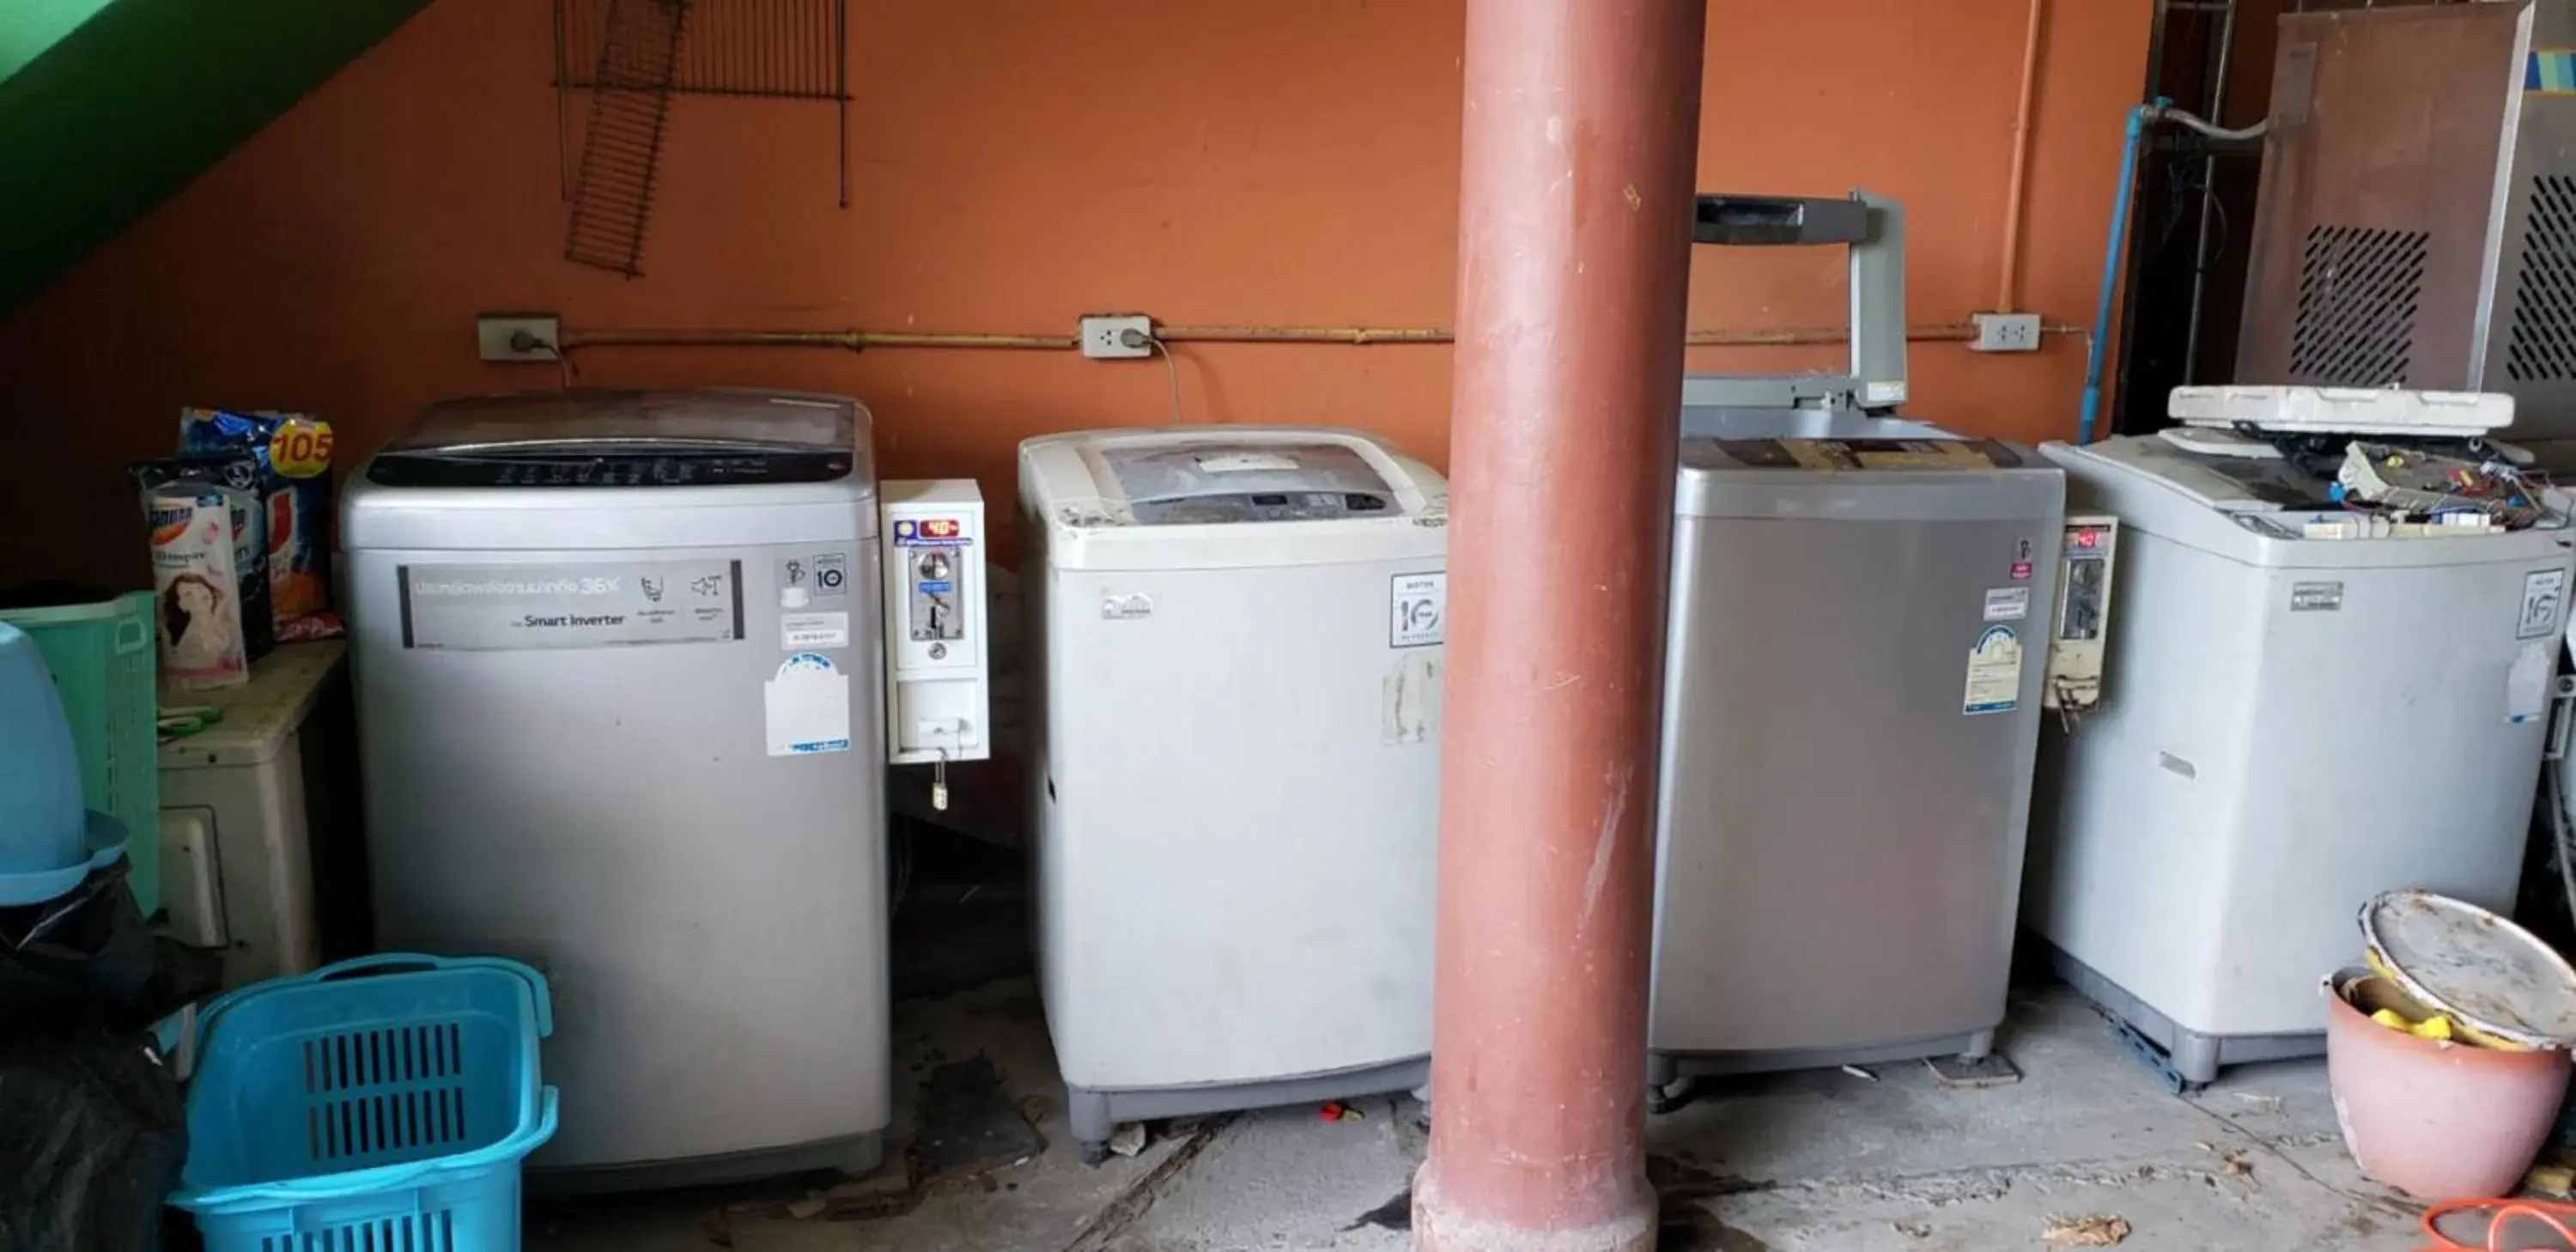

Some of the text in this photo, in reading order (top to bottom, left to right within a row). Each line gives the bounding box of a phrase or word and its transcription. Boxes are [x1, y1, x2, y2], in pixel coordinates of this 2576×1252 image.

[274, 433, 333, 463] 105
[817, 569, 842, 589] 10
[524, 614, 567, 629] Smart
[569, 612, 626, 628] Inverter
